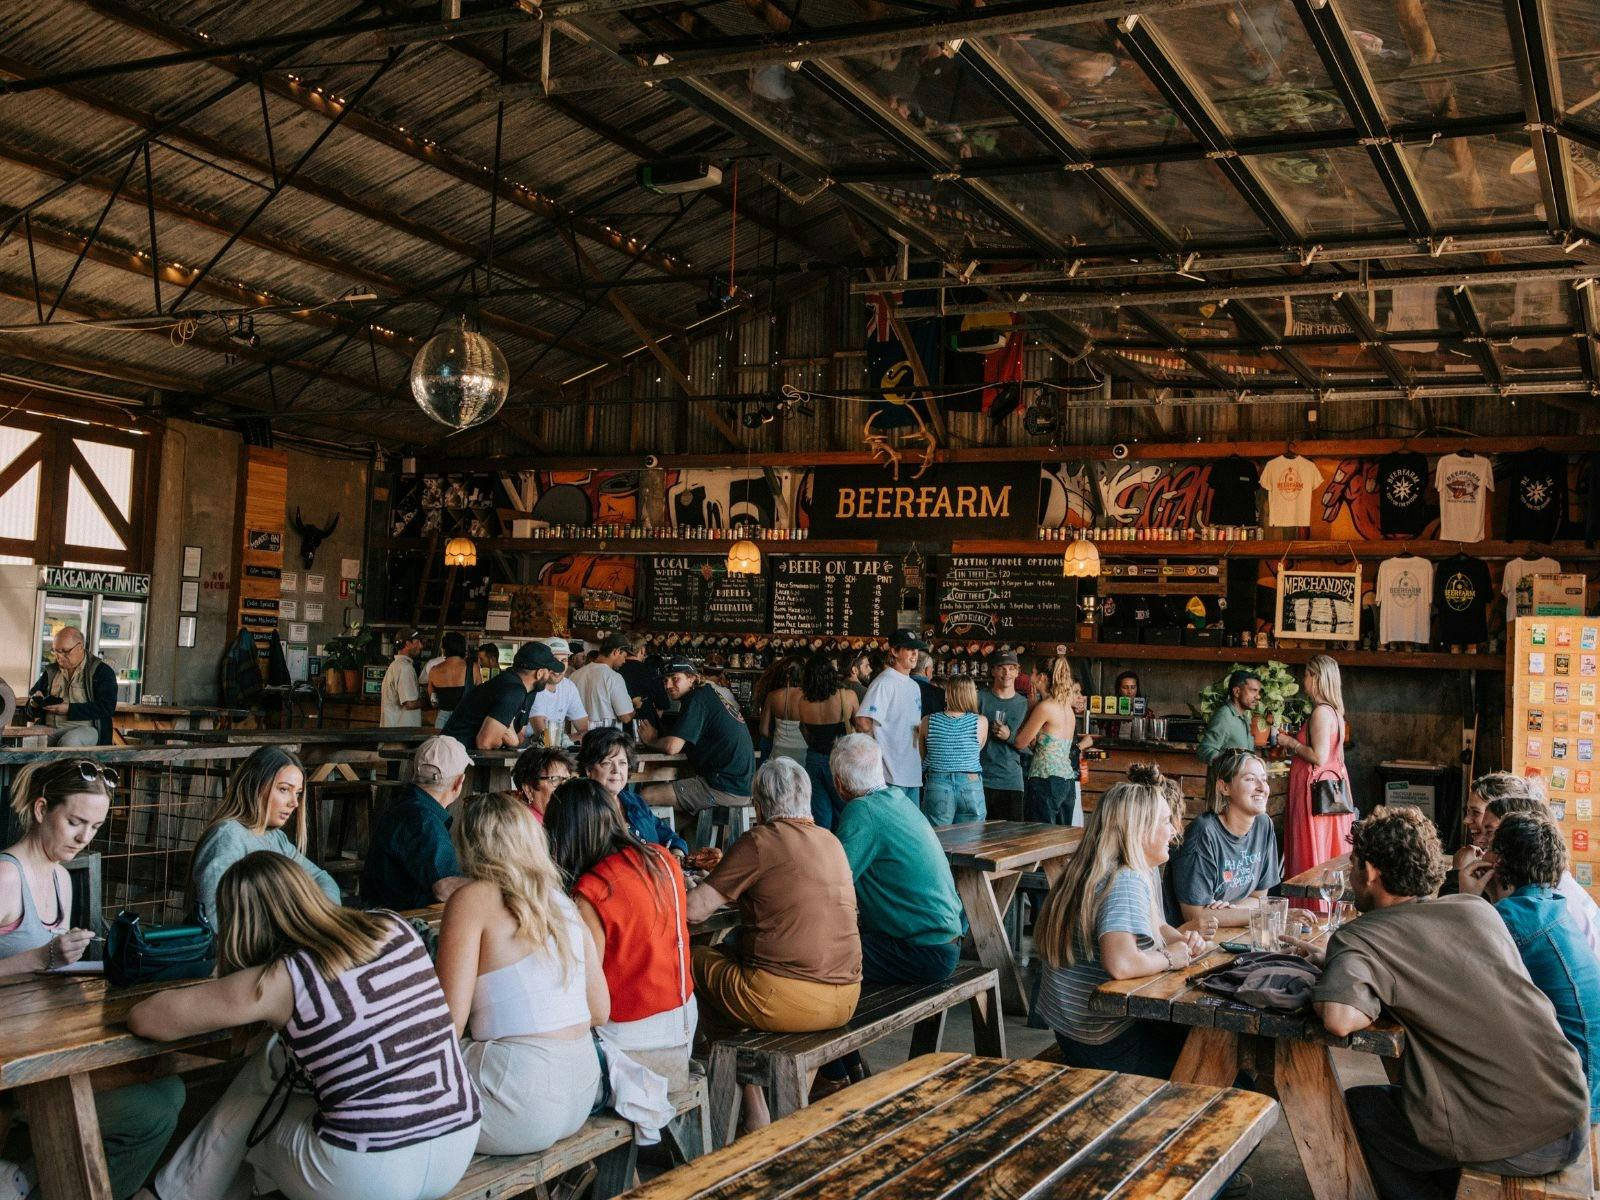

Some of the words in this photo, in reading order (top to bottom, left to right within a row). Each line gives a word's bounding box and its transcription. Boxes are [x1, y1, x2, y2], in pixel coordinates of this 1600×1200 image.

[1387, 468, 1420, 484] BEERFARM
[836, 486, 1012, 518] BEERFARM
[654, 558, 690, 570] LOCAL
[789, 560, 821, 574] BEER
[826, 560, 846, 574] ON
[853, 561, 881, 575] TAP
[952, 558, 988, 566] TASTING
[992, 558, 1022, 566] PADDLE
[1027, 558, 1064, 566] OPTIONS
[48, 568, 106, 590] TAKEAWAY
[109, 574, 149, 594] TINNIES
[1284, 576, 1355, 602] MERCHANDISE
[1390, 587, 1421, 595] BEERFARM
[1444, 589, 1475, 598] BEERFARM
[709, 604, 753, 612] ALTERNATIVE
